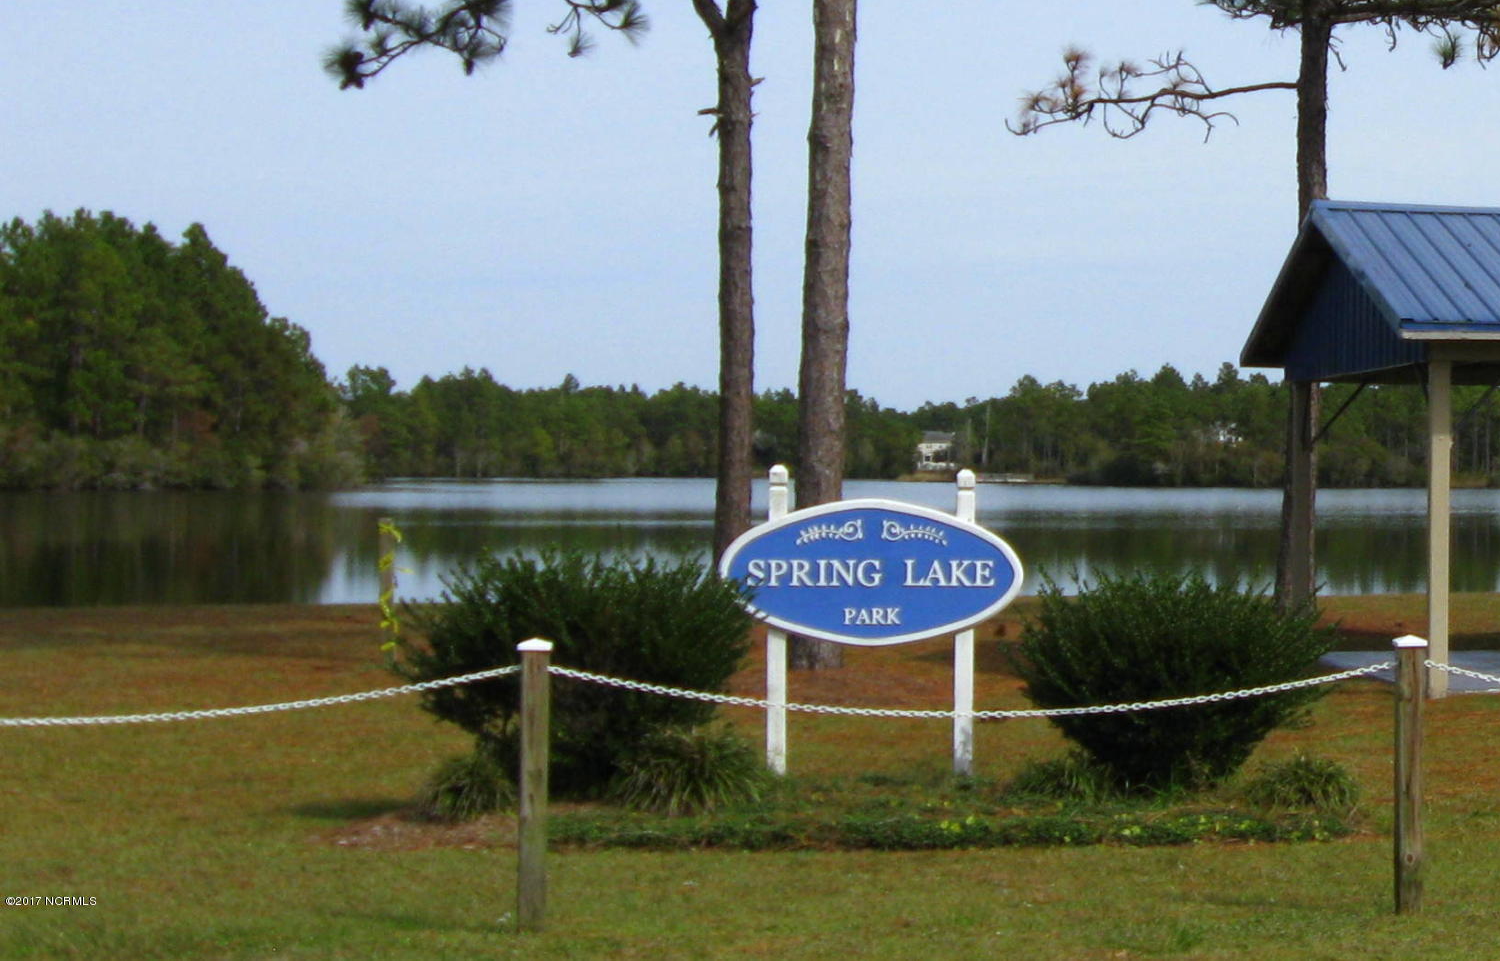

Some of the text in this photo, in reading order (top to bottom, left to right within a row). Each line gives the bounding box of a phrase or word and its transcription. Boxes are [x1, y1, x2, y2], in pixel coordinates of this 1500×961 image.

[746, 559, 995, 588] SPRING LAKE
[843, 607, 901, 625] PARK
